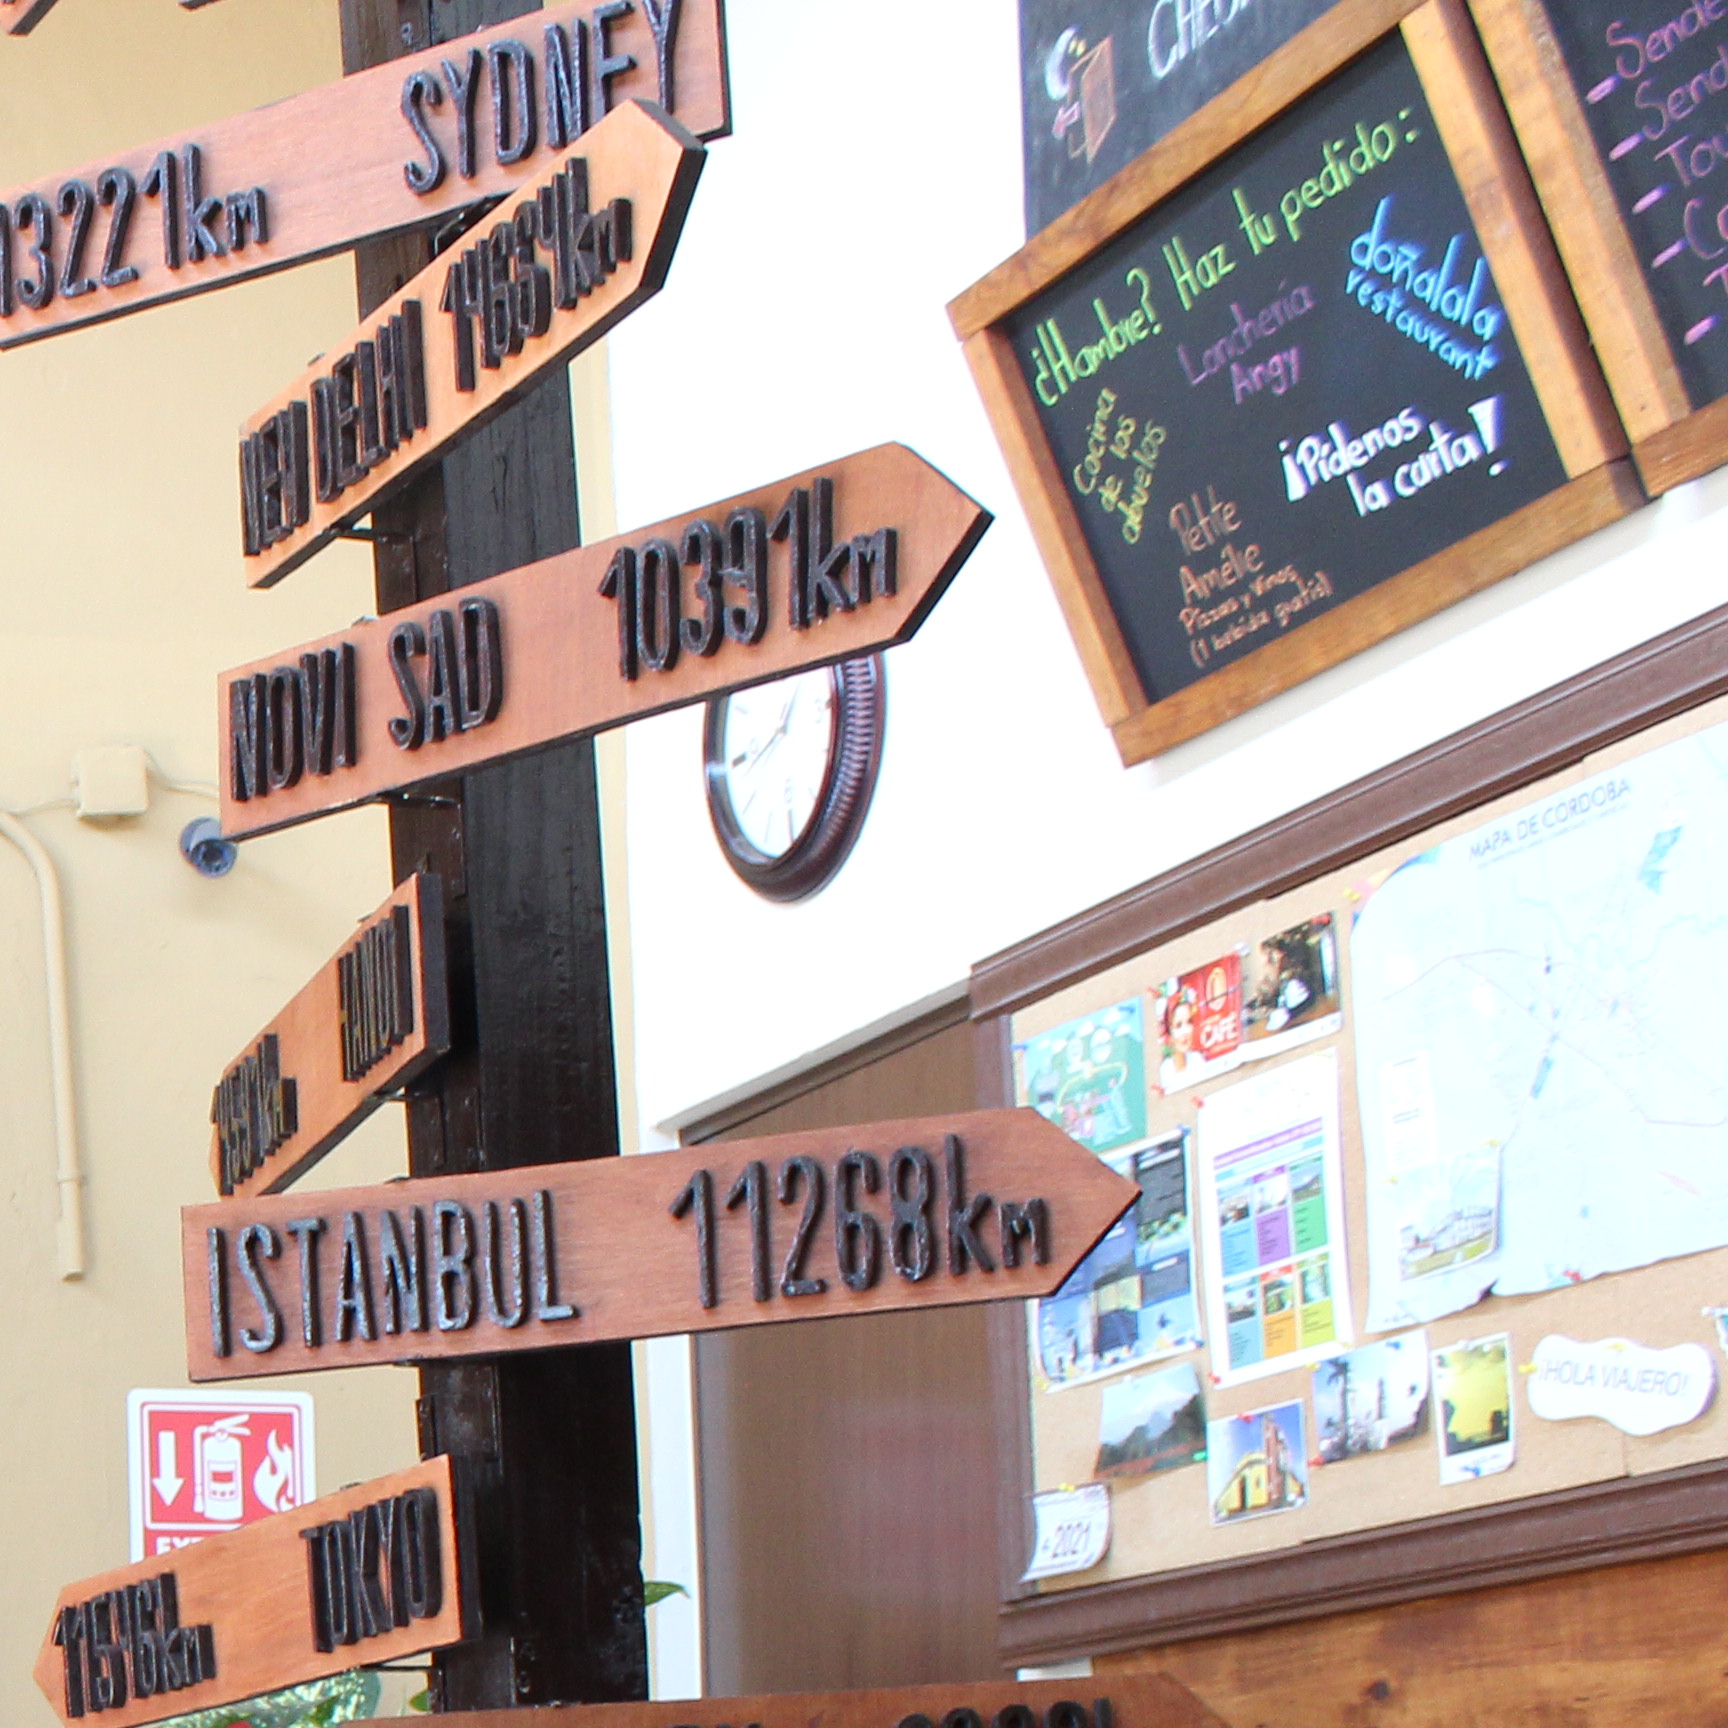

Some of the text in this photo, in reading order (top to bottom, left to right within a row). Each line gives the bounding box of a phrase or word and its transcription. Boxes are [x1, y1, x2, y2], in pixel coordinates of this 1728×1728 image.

[1031, 266, 1163, 407] ¿Hambre?
[1162, 236, 1237, 311] Haz
[1231, 187, 1281, 256] tu
[309, 298, 428, 503] DELHI
[1230, 344, 1302, 404] Angy
[1073, 387, 1118, 496] Cocina
[1098, 474, 1125, 512] de
[1117, 418, 1167, 545] abuelos
[1346, 394, 1510, 517] la carta!
[230, 476, 898, 803] NOVI SAD 10391km
[1516, 814, 1542, 842] DE
[206, 1134, 1049, 1359] ISTANBUL 11268km
[299, 1487, 444, 1654] TOKYO
